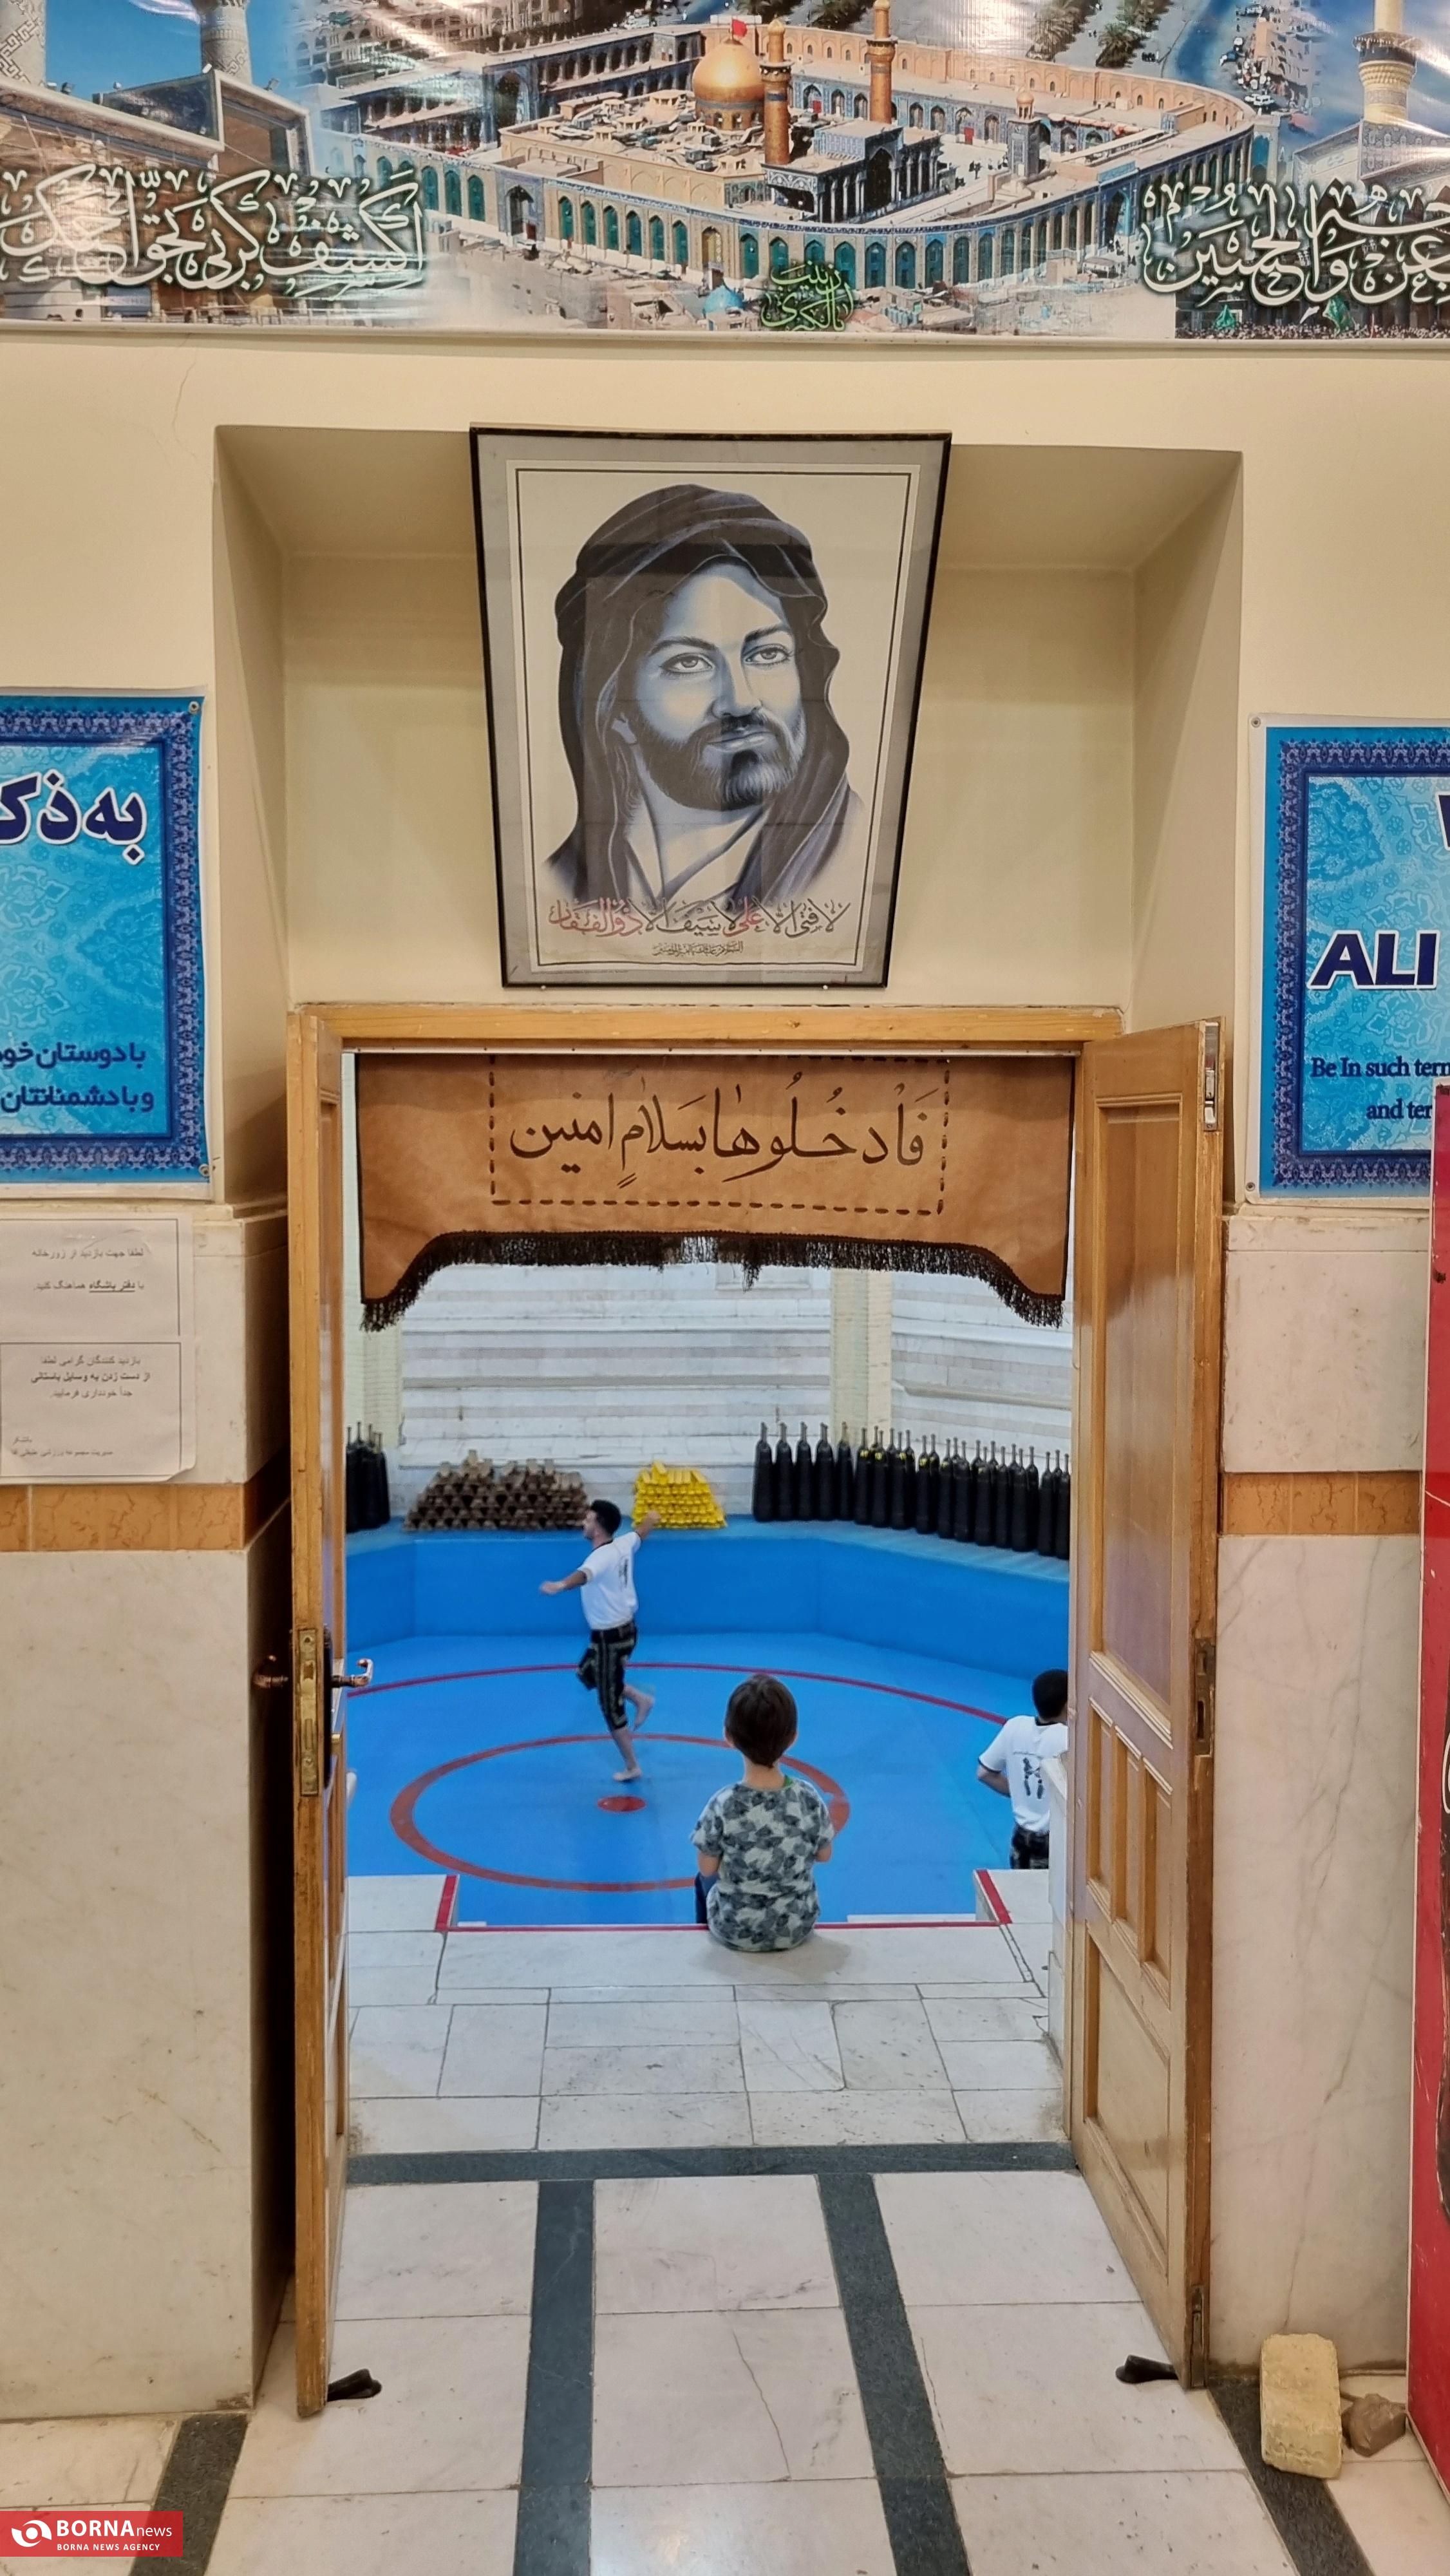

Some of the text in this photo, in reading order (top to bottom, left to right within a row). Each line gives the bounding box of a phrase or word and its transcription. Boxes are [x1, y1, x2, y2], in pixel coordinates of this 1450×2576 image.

[83, 787, 147, 865] به
[1307, 930, 1440, 989] ALI
[0, 1041, 33, 1069] خو
[1310, 1057, 1337, 1077] Be
[1340, 1057, 1362, 1077] In
[1366, 1056, 1411, 1077] such
[1366, 1098, 1404, 1119] and
